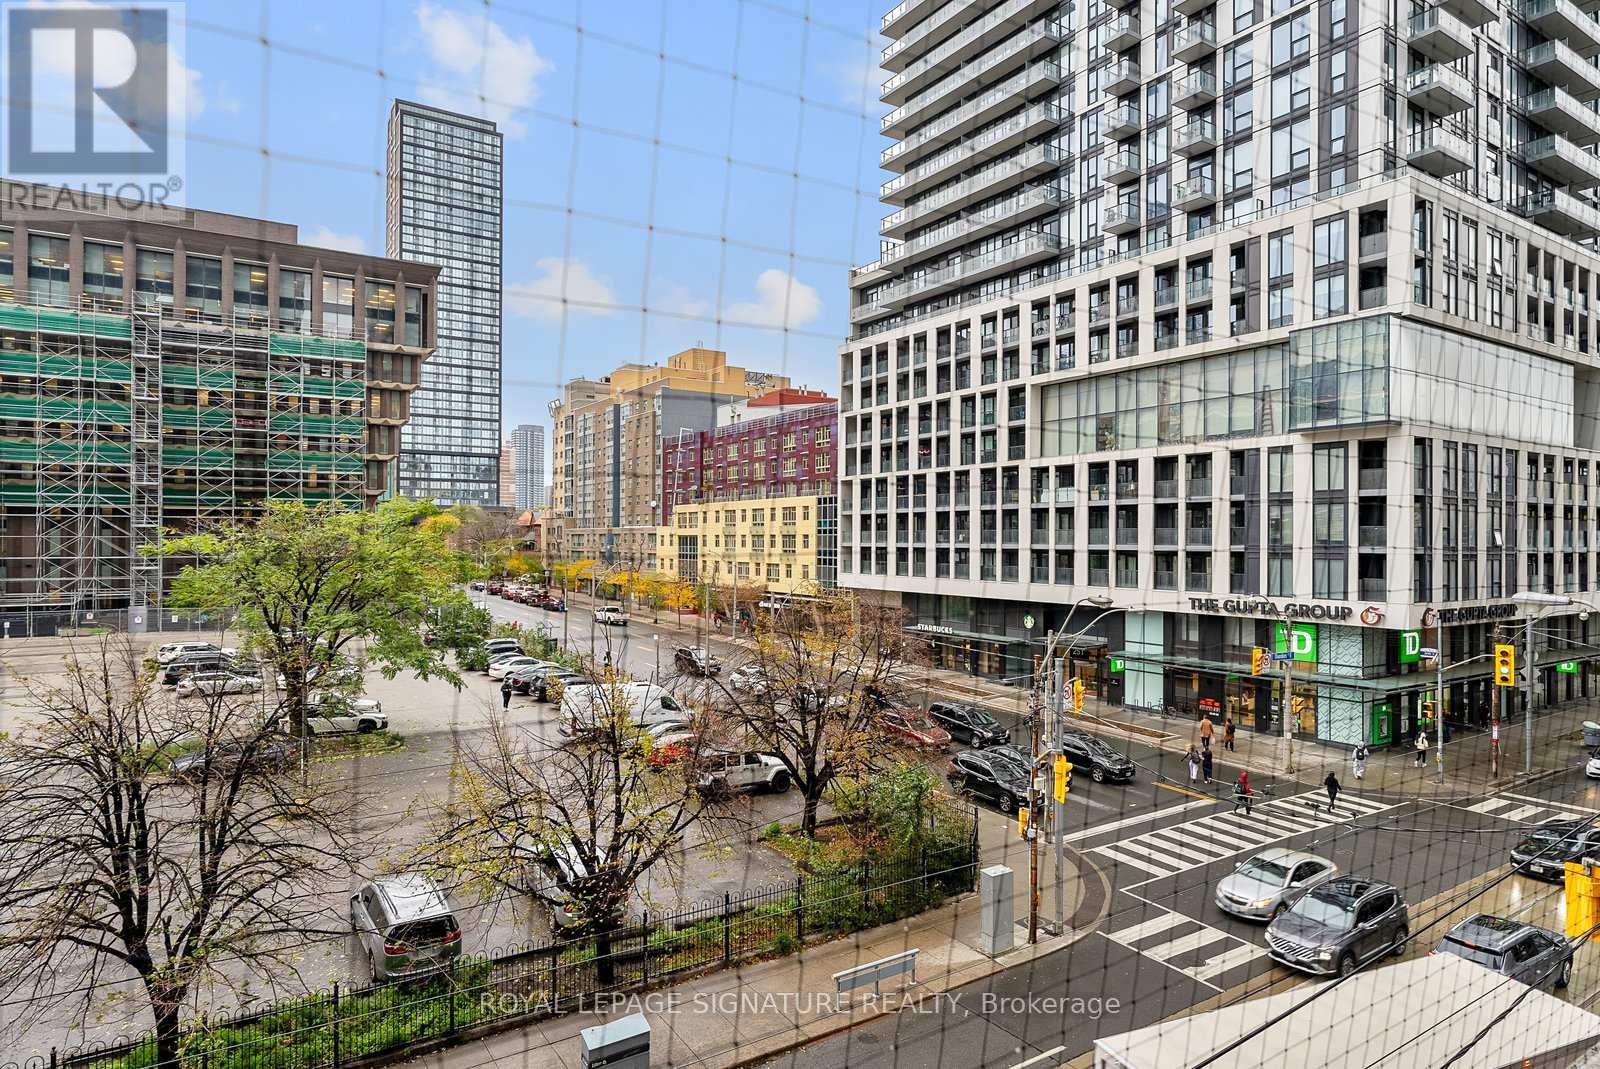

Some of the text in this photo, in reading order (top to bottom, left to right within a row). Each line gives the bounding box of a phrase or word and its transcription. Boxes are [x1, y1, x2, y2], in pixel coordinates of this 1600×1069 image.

[1188, 597, 1353, 621] THE GUPTA GROUP
[1438, 604, 1518, 623] THE GUPTA GROUP
[917, 623, 953, 634] STARBUCKS
[1402, 632, 1420, 655] TD
